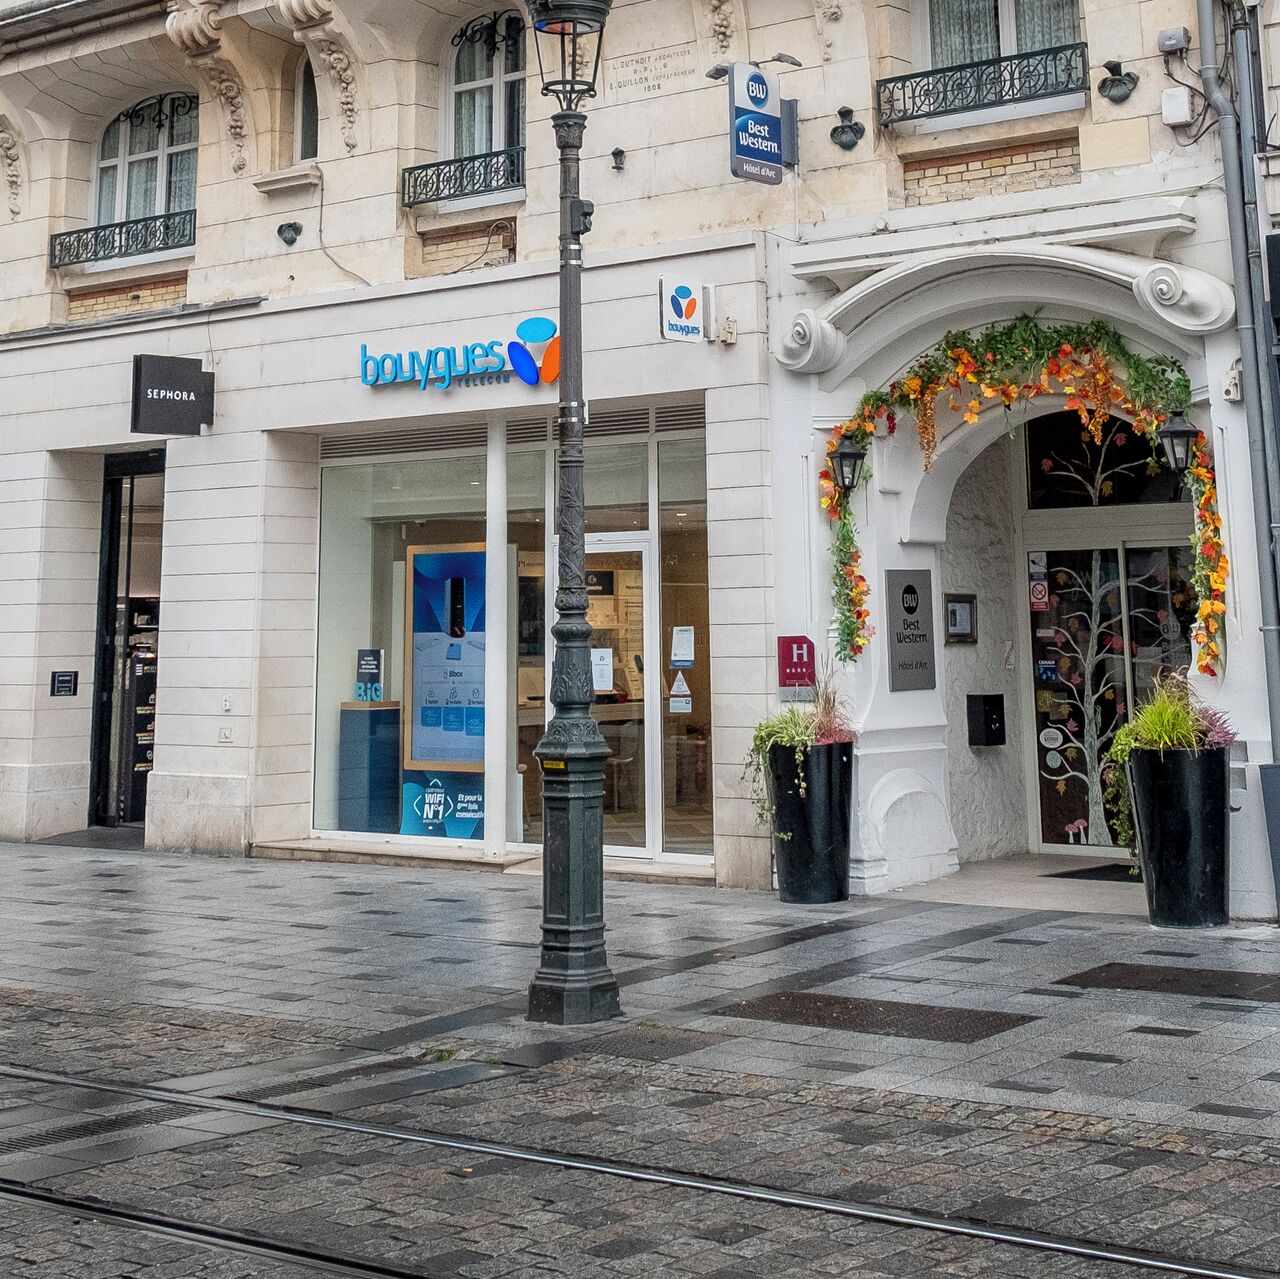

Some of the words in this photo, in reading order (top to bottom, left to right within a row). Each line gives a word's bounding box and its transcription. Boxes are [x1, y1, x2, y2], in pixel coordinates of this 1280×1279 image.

[748, 81, 766, 99] BW
[747, 120, 770, 138] Best
[739, 131, 779, 154] Western
[743, 162, 761, 176] Hôtel
[761, 165, 776, 179] d'Arc
[668, 319, 700, 336] bouygues
[360, 340, 506, 392] bouygues
[457, 374, 511, 388] TELECOM
[146, 388, 196, 401] SEPHORA
[903, 593, 918, 608] BW
[902, 618, 920, 631] Best
[896, 631, 928, 644] Western
[792, 643, 808, 662] H
